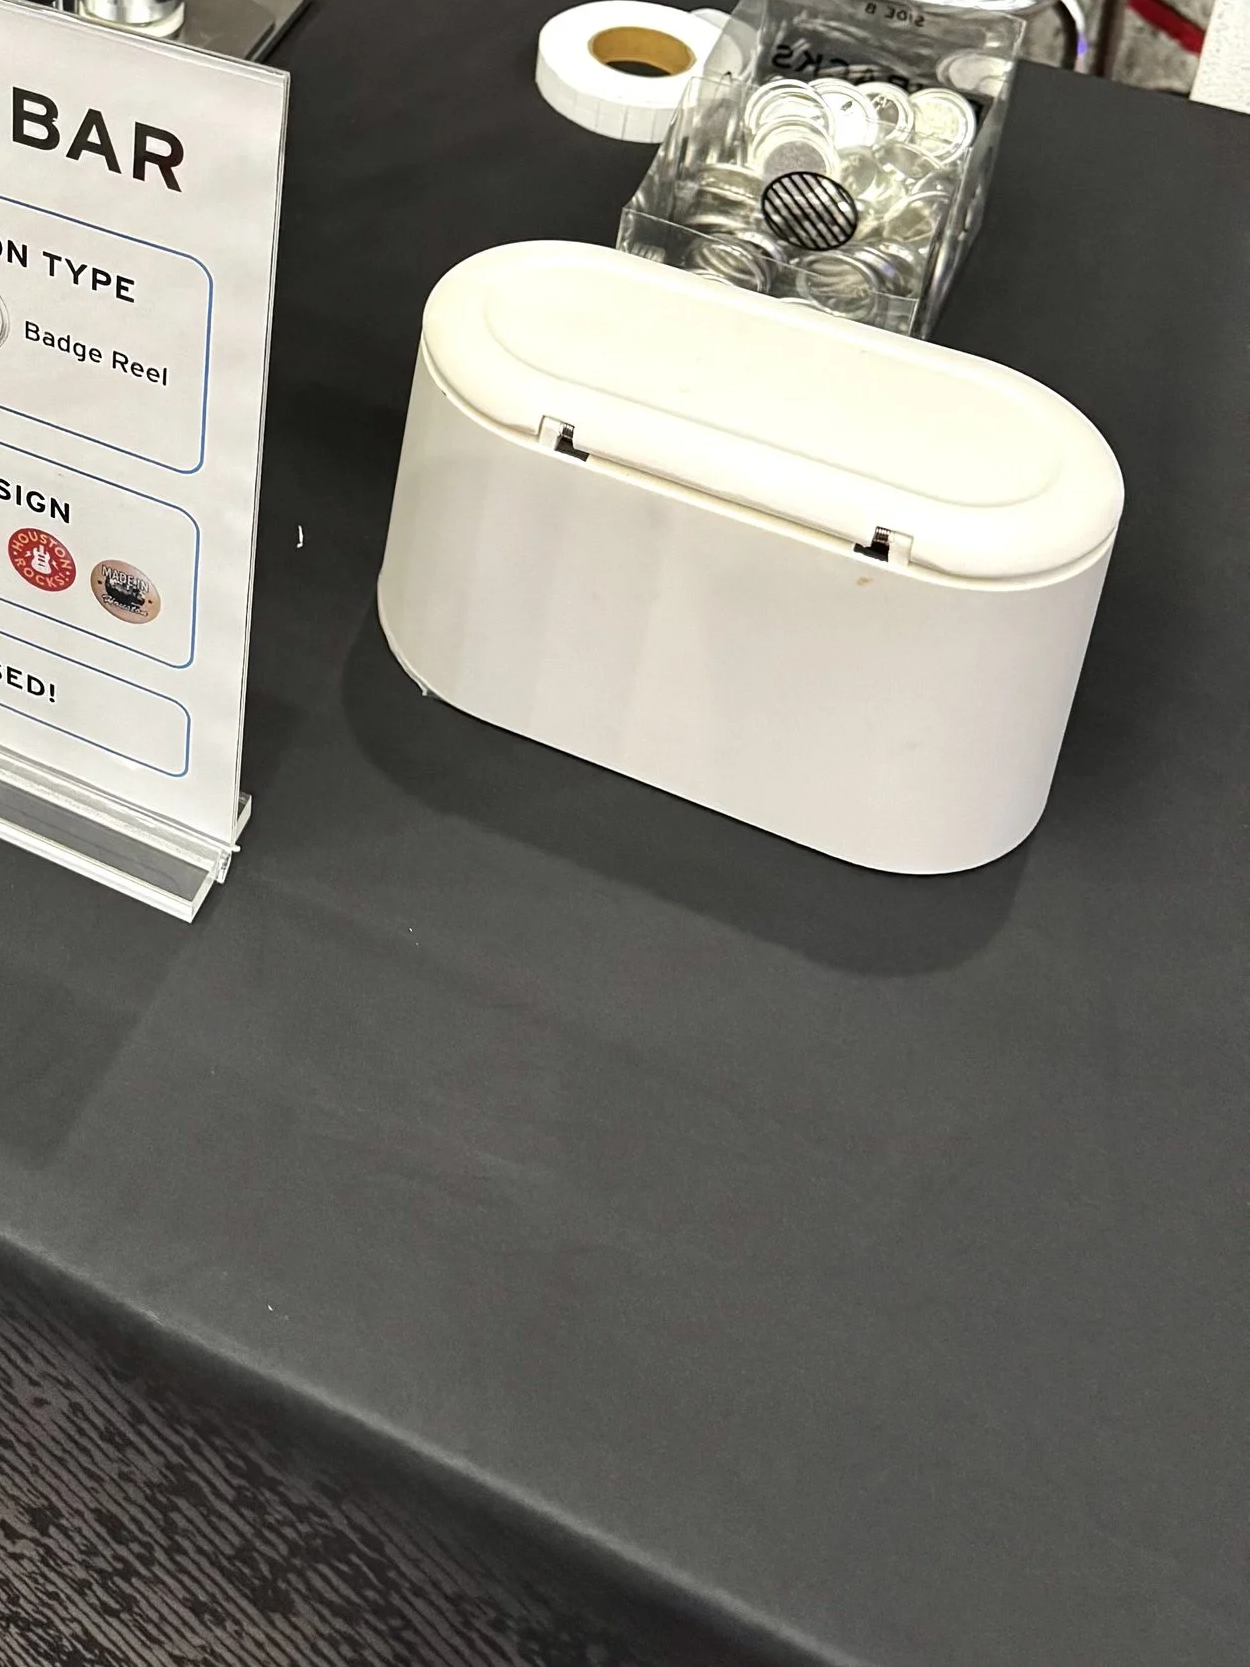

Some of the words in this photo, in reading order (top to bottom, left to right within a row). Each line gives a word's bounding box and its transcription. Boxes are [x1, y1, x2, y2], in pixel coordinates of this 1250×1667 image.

[11, 86, 184, 193] BAR
[42, 251, 136, 304] TYPE
[25, 320, 102, 362] Badge
[112, 350, 168, 386] Reel
[12, 531, 72, 570] HOUSTON
[14, 558, 69, 588] ROCKS!
[102, 594, 149, 617] Houston
